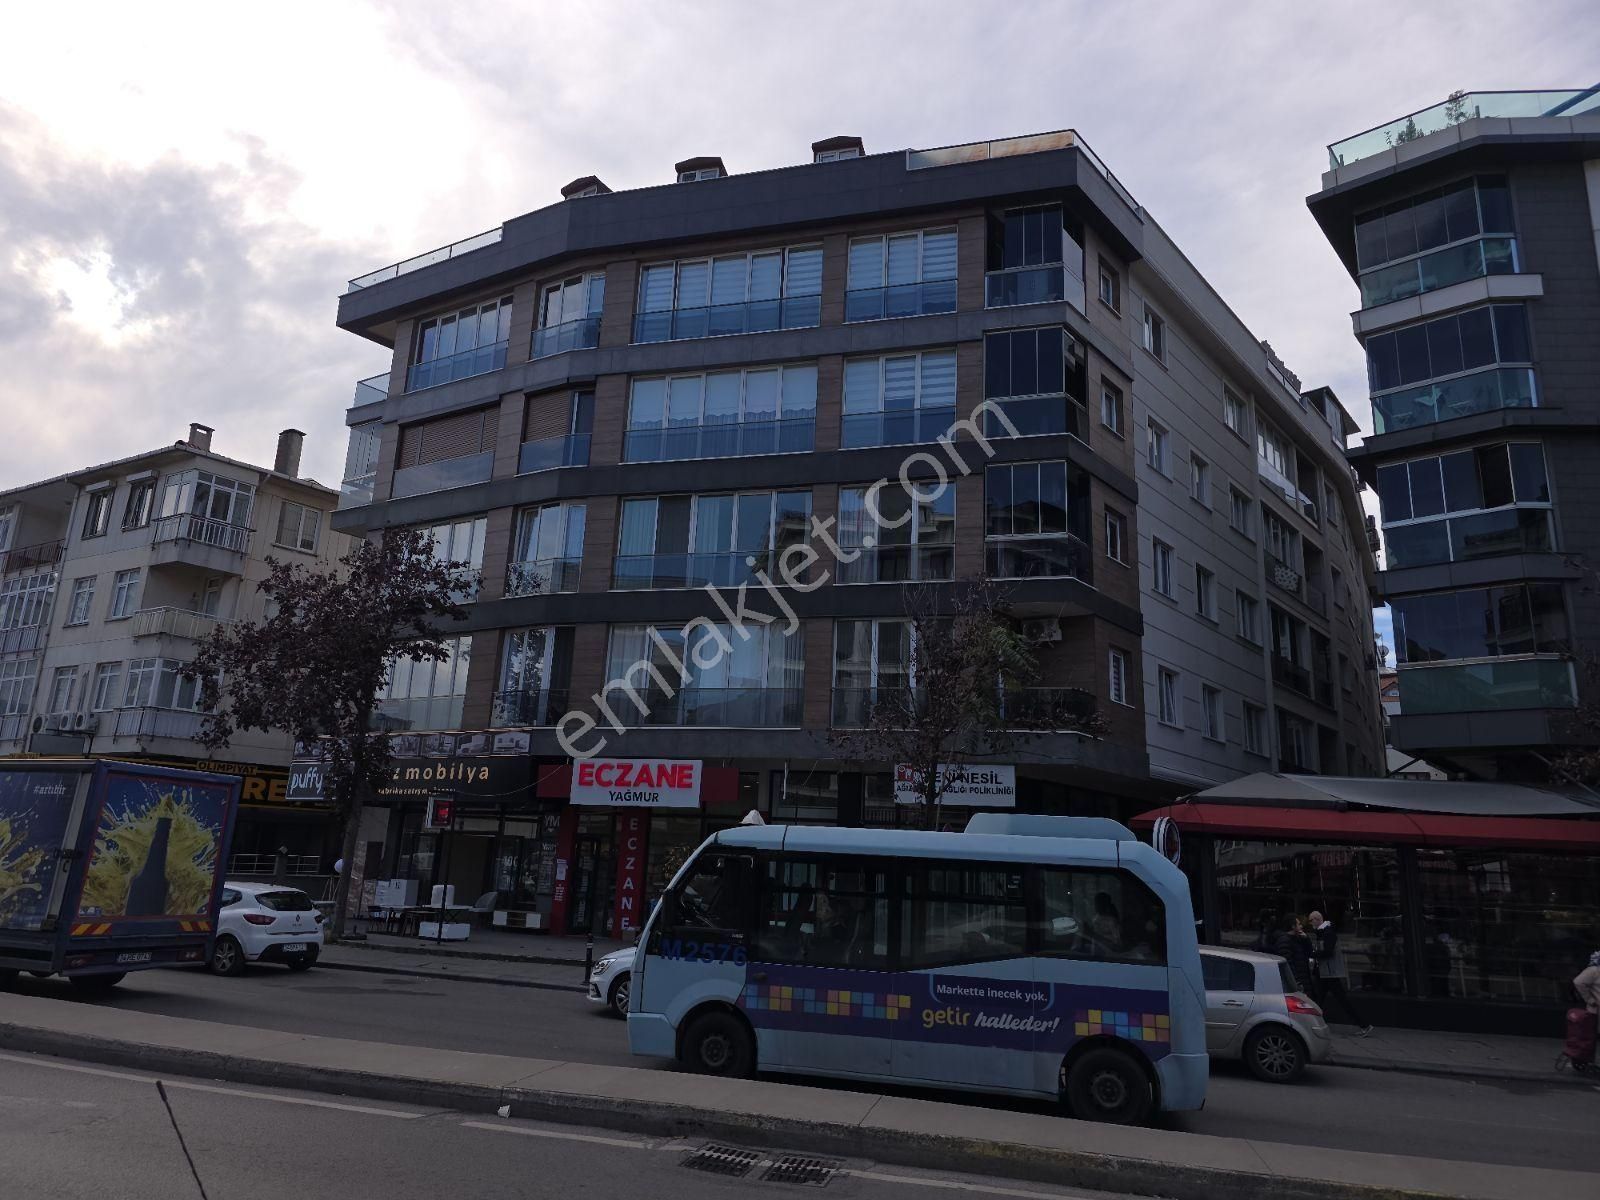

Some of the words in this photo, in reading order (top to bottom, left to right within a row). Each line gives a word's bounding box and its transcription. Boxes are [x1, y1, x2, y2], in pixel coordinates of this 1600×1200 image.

[290, 766, 324, 795] puffy
[405, 762, 490, 784] mobilya
[578, 762, 694, 789] ECZANE
[608, 788, 660, 803] YAĞMUR
[620, 817, 640, 930] ECZANE
[660, 939, 749, 967] M2576
[936, 984, 985, 997] Markette
[987, 987, 1022, 1000] inecek
[1024, 991, 1048, 1003] yok.
[921, 1006, 971, 1029] getir
[973, 1011, 1061, 1033] halleder!
